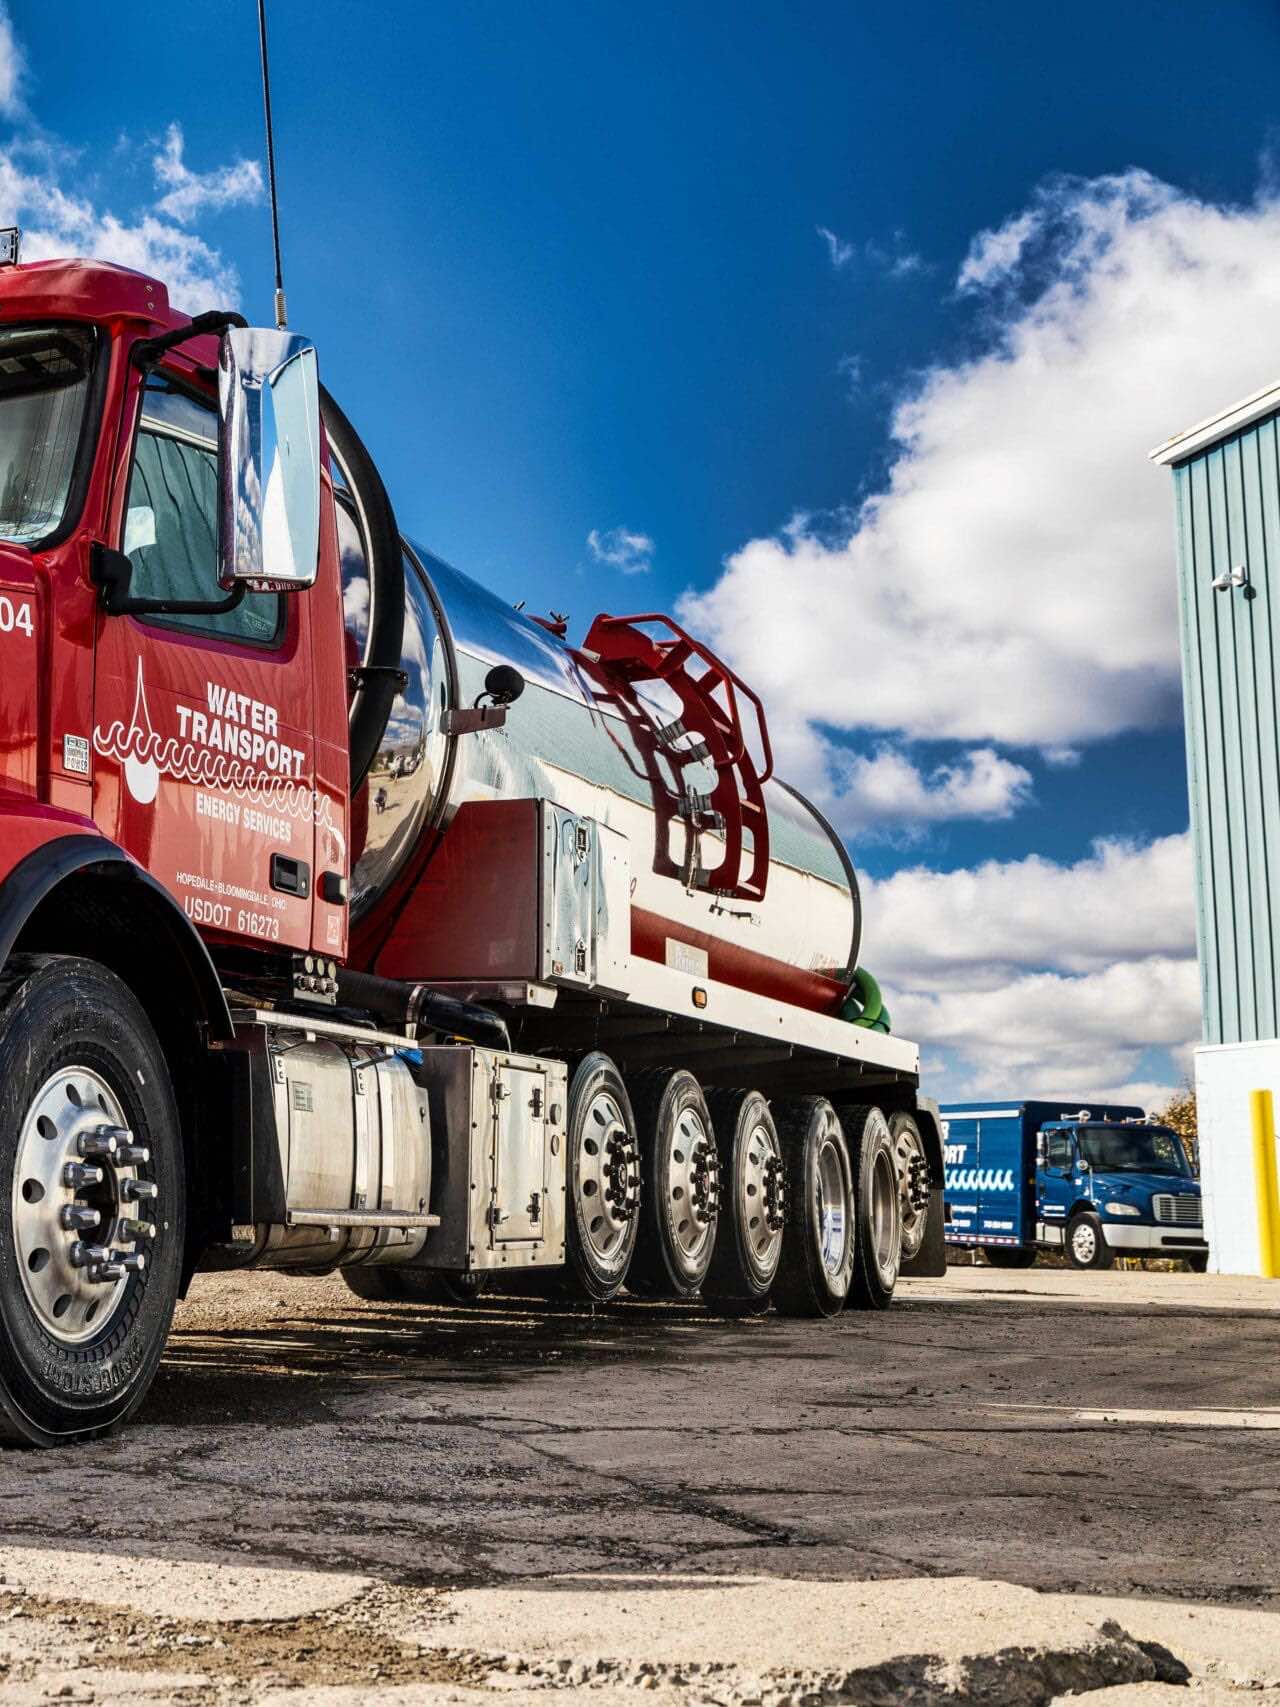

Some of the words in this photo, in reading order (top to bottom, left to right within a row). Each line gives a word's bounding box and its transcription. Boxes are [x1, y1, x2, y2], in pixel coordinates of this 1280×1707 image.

[207, 681, 278, 738] WATER
[176, 704, 306, 779] TRANSPORT
[196, 791, 241, 825] ENERGY
[243, 807, 292, 842] SERVICES
[184, 895, 232, 928] USDOT
[237, 909, 280, 940] 616273
